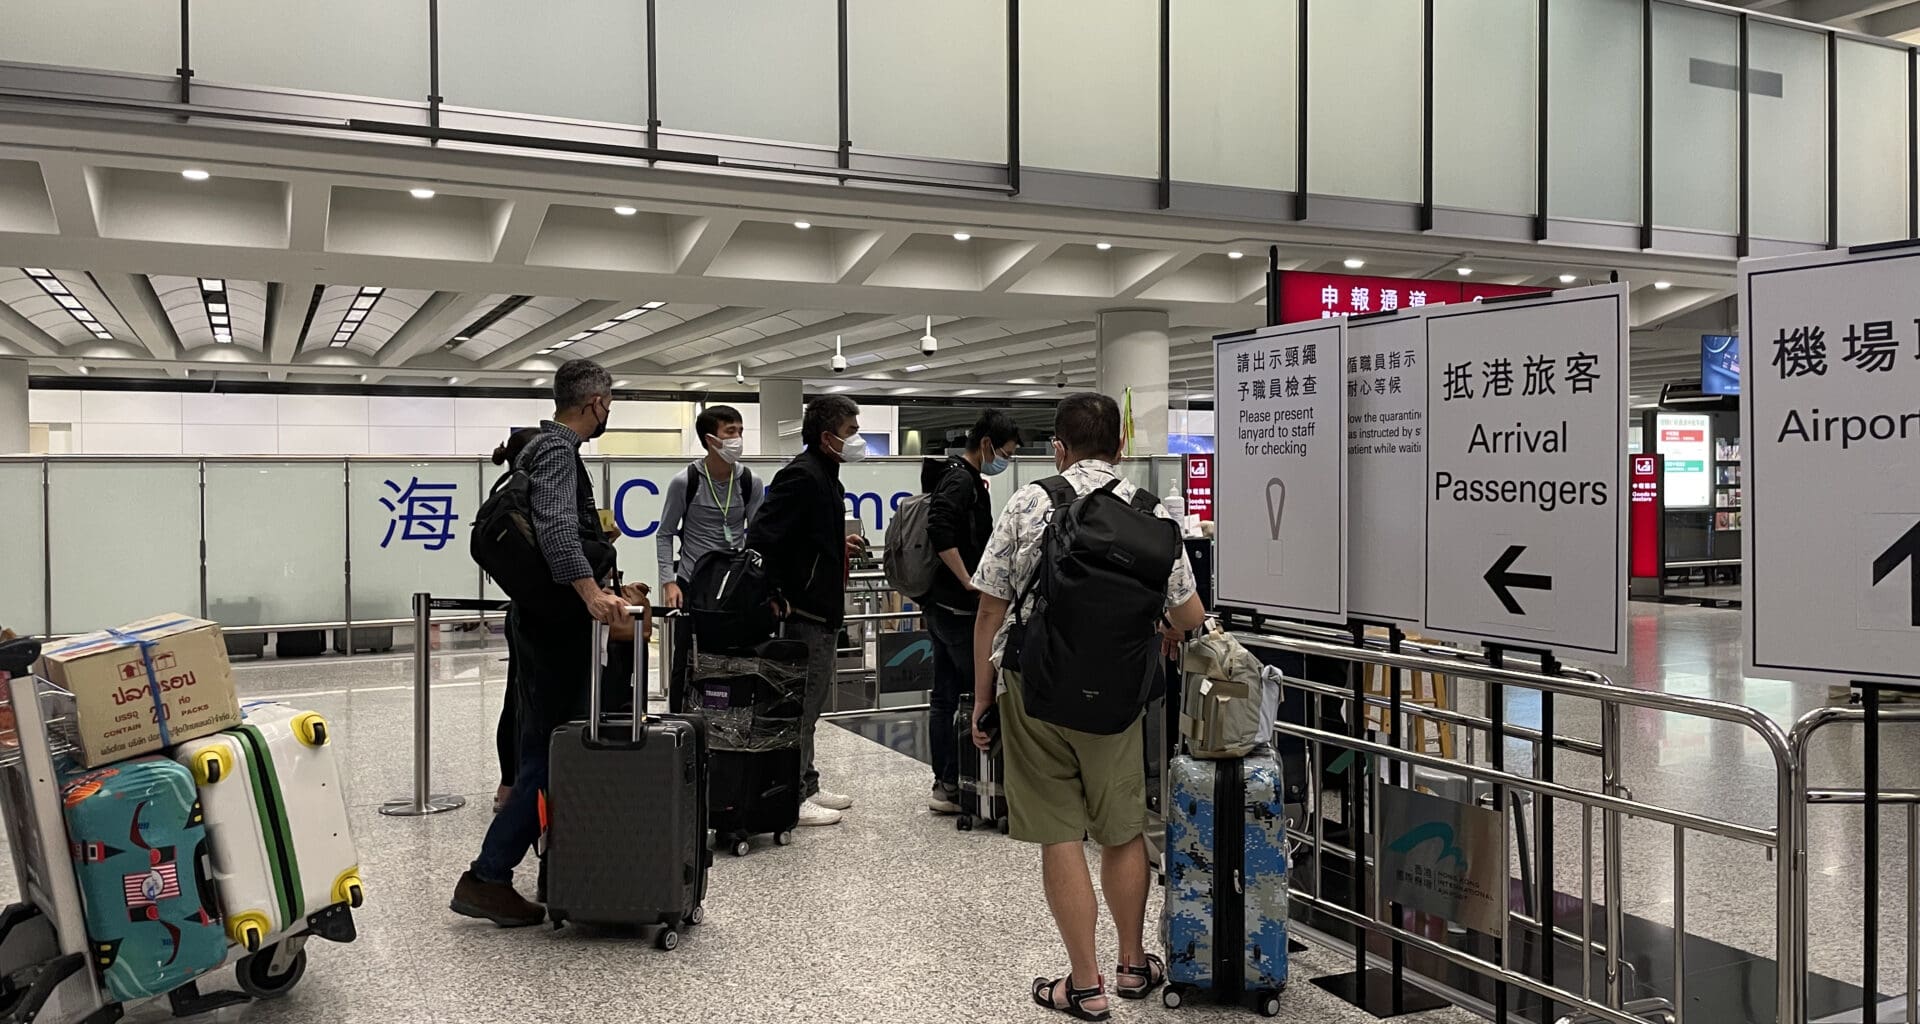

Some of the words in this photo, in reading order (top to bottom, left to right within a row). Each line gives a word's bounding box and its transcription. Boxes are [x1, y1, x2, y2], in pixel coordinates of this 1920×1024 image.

[1321, 285, 1427, 312] 申報通道
[1237, 344, 1317, 373] 請出示頸繩
[1772, 319, 1920, 379] 機場
[1237, 374, 1317, 401] 予職員檢查
[1443, 351, 1600, 401] 抵港旅客
[1239, 410, 1271, 423] Please
[1274, 406, 1314, 424] present
[1348, 412, 1362, 424] low
[1364, 412, 1377, 423] the
[1238, 425, 1275, 442] lanyard
[1278, 426, 1289, 438] to
[1291, 422, 1316, 437] staff
[1360, 427, 1400, 439] instructed
[1402, 426, 1413, 439] by
[1468, 420, 1567, 453] Arrival
[1245, 442, 1258, 456] for
[1261, 440, 1307, 457] checking
[1374, 443, 1396, 454] while
[1435, 471, 1607, 512] Passengers
[378, 476, 459, 551] 海
[104, 723, 142, 738] CONTAIN
[181, 704, 209, 717] PACKS
